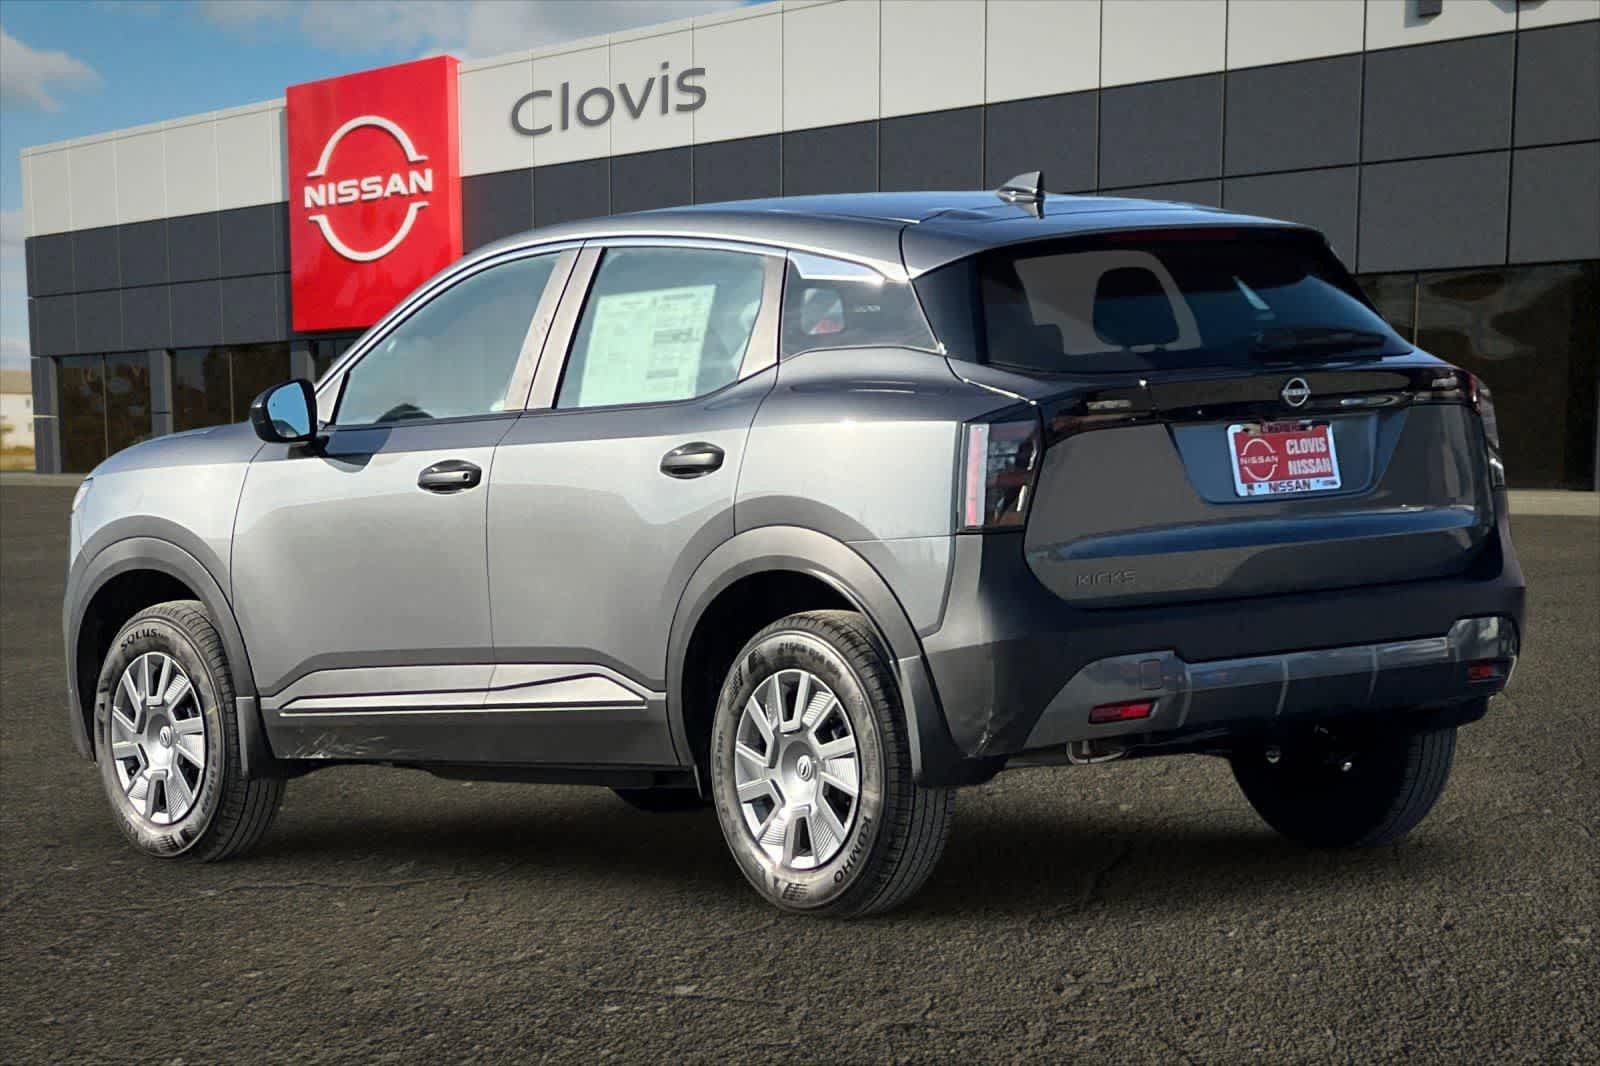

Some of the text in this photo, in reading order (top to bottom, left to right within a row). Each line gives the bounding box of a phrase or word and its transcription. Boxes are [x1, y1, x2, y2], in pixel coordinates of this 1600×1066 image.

[511, 61, 707, 136] Clovis
[304, 168, 433, 208] NISSAN
[1286, 437, 1326, 455] CLOVIS
[1240, 456, 1279, 465] NISSAN
[1288, 458, 1331, 475] NISSAN
[1269, 479, 1311, 493] NISSAN
[1075, 568, 1137, 585] KICKS
[120, 628, 158, 652] SOLUS
[833, 816, 872, 883] KUMHO
